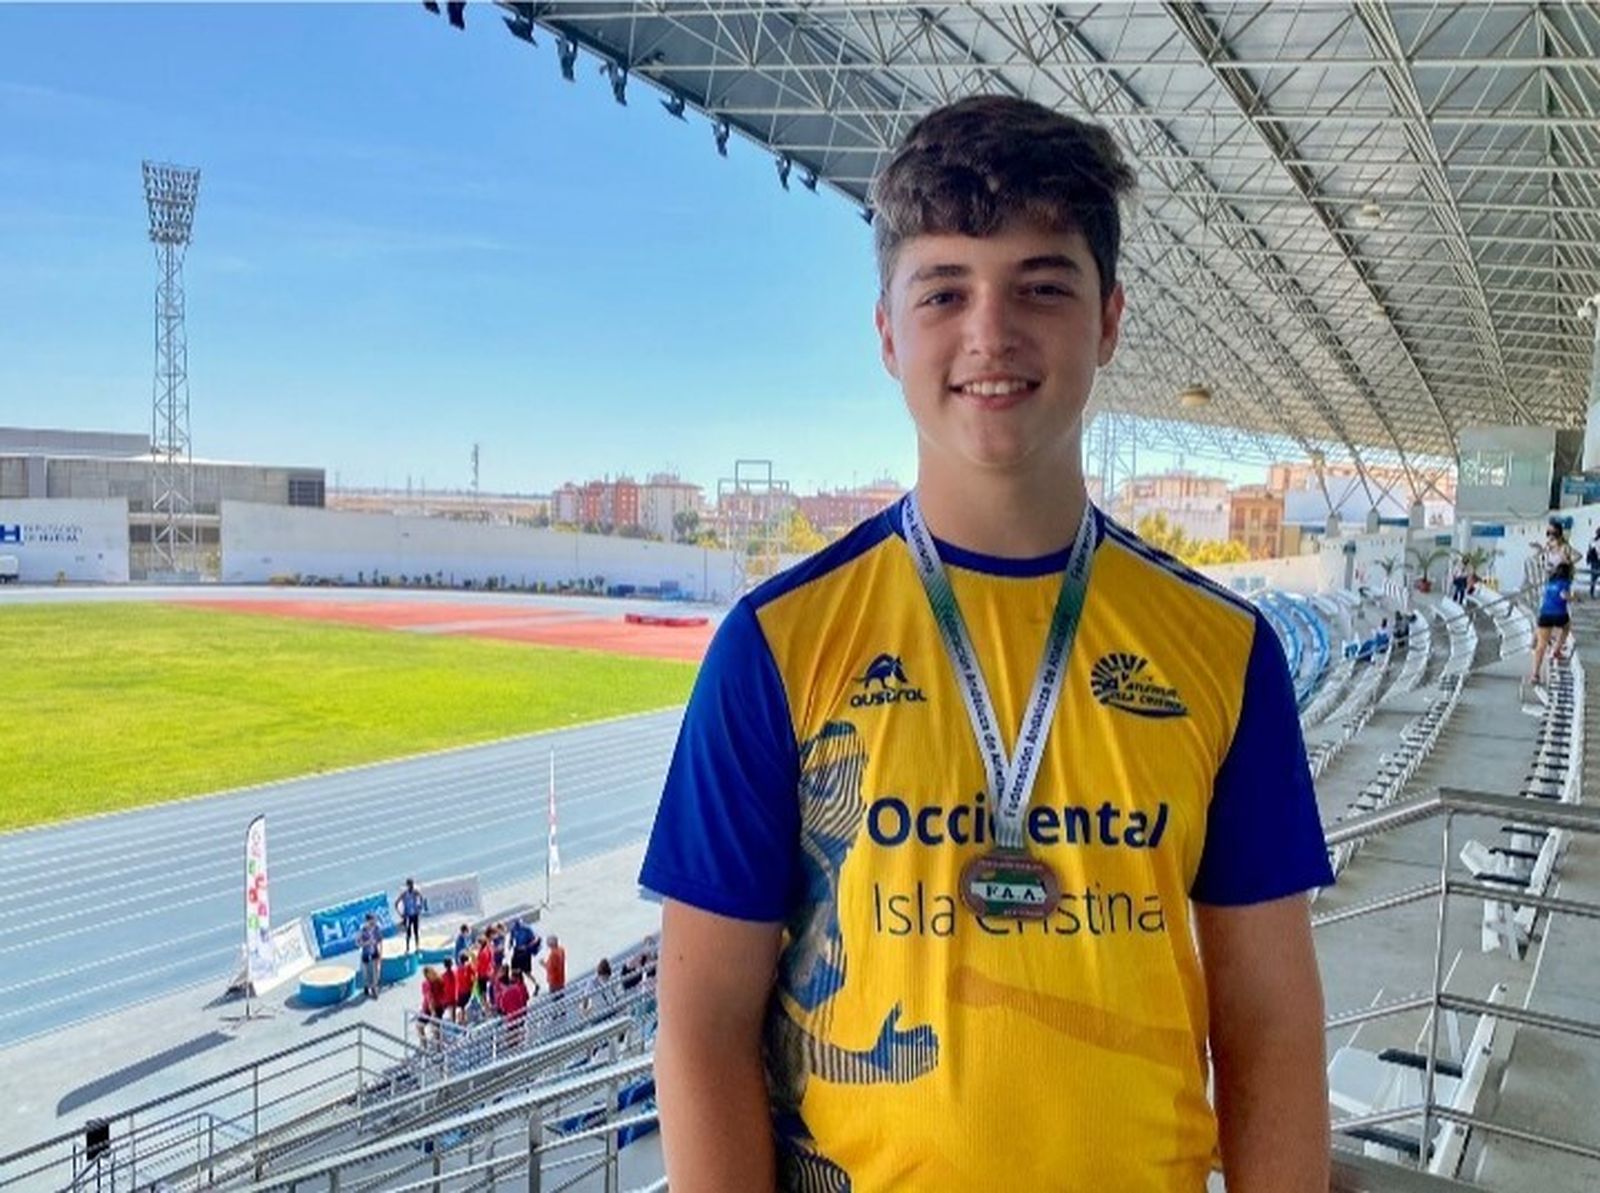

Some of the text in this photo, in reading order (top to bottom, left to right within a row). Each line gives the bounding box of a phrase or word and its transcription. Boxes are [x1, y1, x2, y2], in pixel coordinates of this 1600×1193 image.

[984, 733, 997, 750] de
[1004, 745, 1034, 818] Federación
[867, 793, 1168, 848] Occiental
[874, 881, 956, 937] Isla
